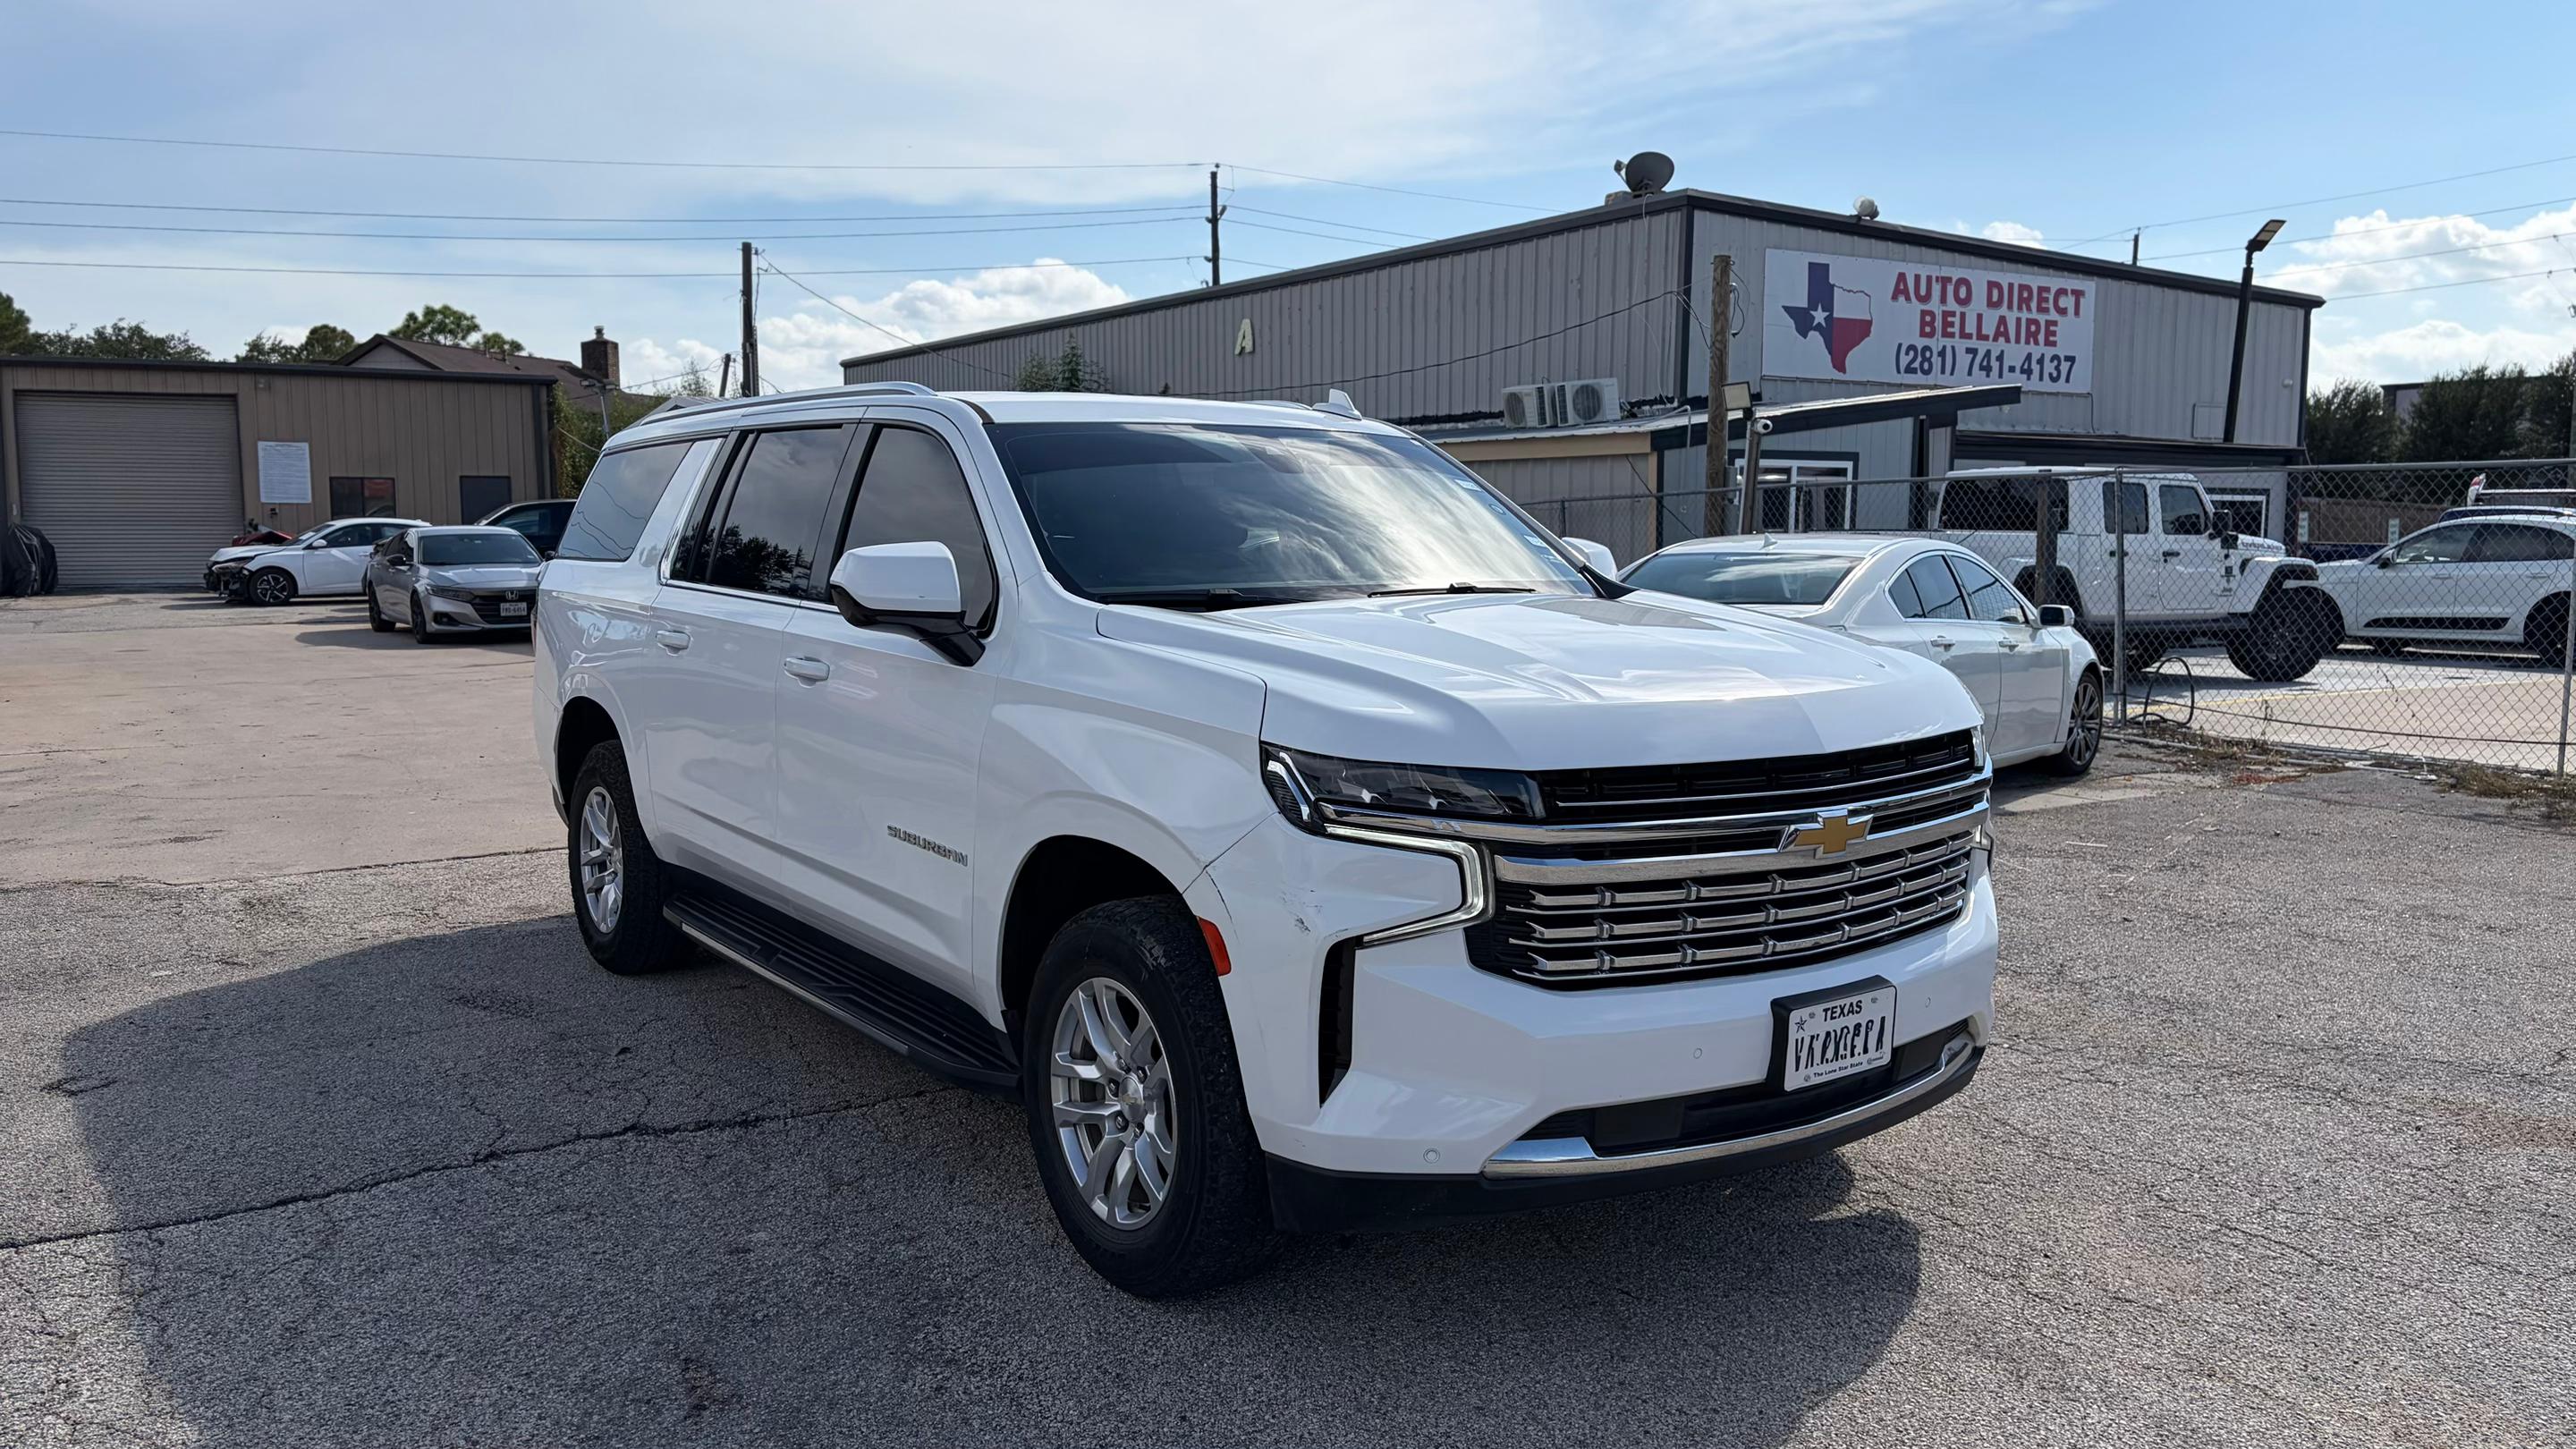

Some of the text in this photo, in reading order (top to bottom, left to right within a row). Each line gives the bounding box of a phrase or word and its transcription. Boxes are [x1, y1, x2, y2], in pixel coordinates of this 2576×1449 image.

[1891, 272, 2086, 318] AUTO DIRECT
[1234, 318, 1254, 355] A
[1919, 309, 2059, 347] BELLAIRE
[1895, 343, 2077, 384] (281) 741-4137
[886, 825, 969, 867] SUBURBAN
[1822, 999, 1863, 1022] TEXAS
[1838, 1064, 1849, 1072] Star
[1850, 1061, 1863, 1069] State
